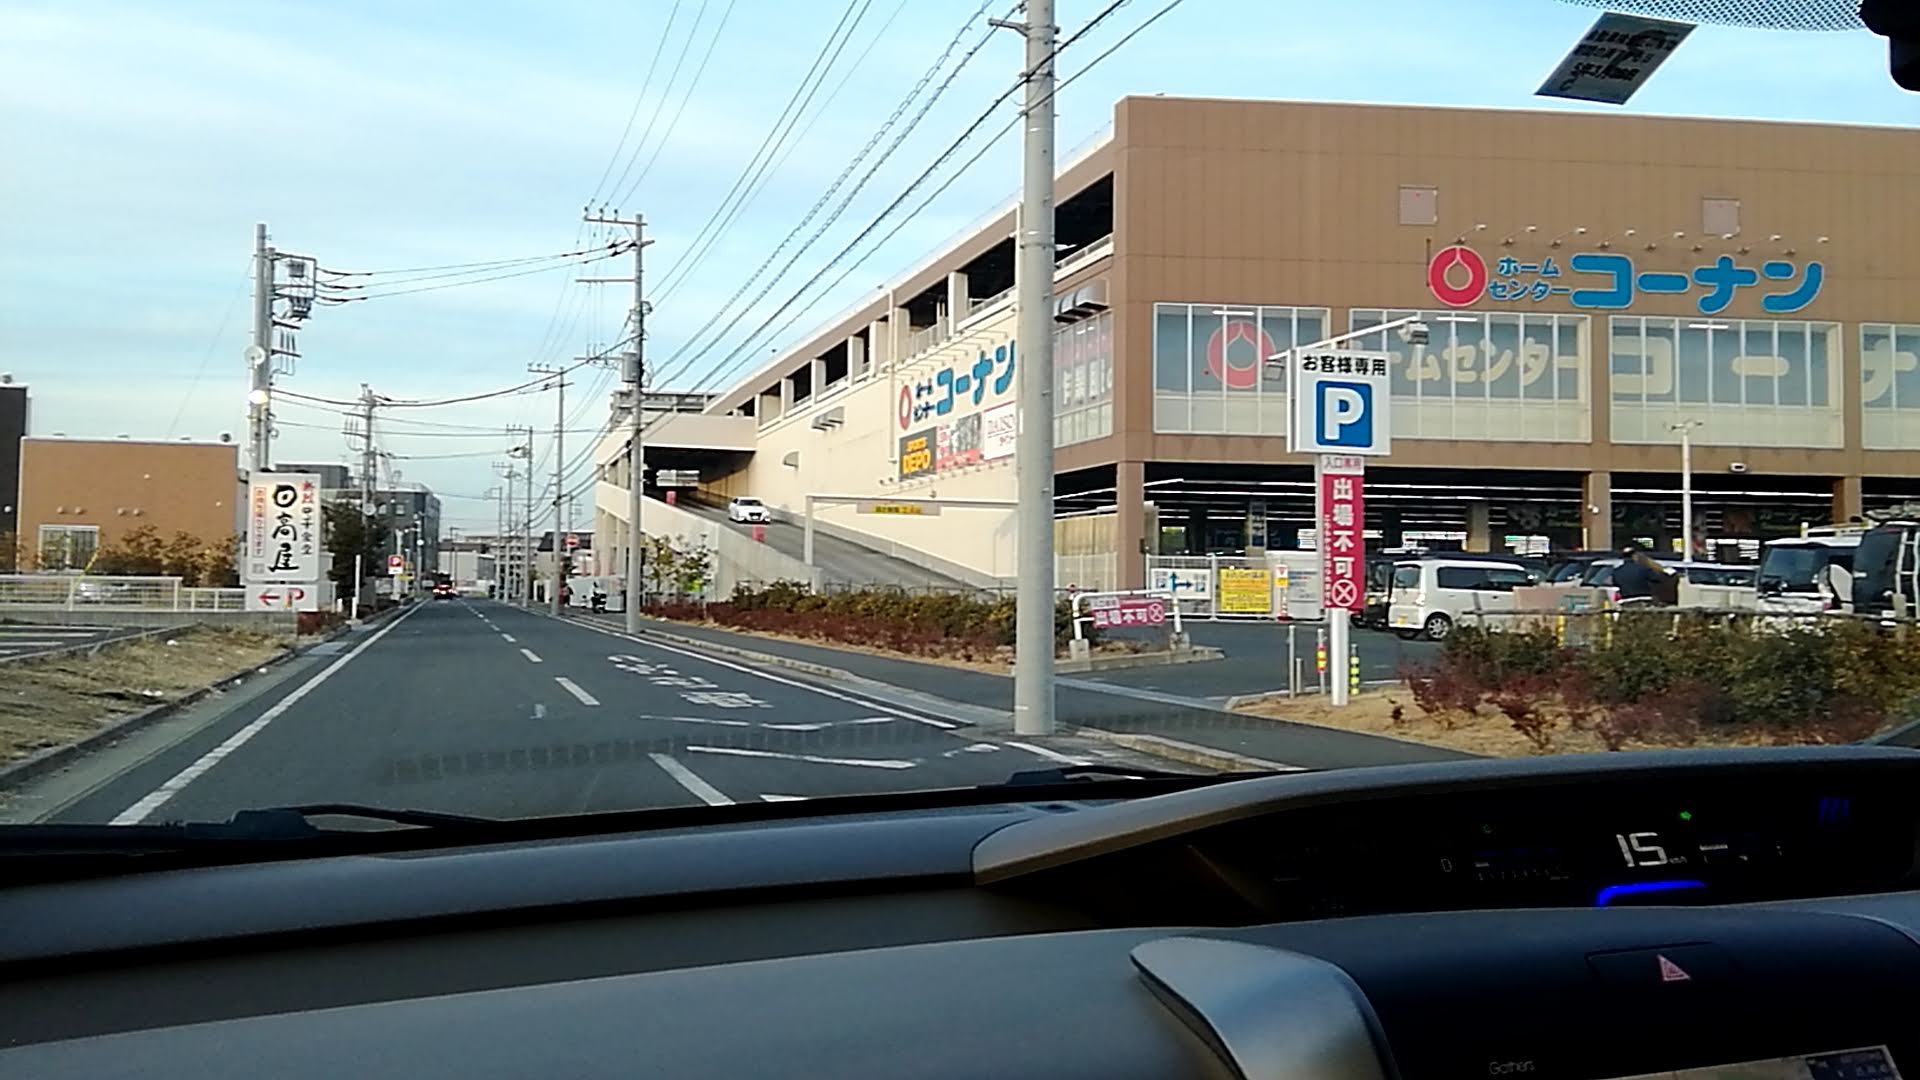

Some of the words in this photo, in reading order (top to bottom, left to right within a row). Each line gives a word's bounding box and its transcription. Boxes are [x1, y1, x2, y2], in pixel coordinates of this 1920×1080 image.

[1497, 257, 1561, 277] ホーム
[1570, 253, 1824, 313] コーナン
[1488, 281, 1571, 302] センター
[936, 339, 1015, 417] コーナン
[1302, 355, 1387, 377] お客様専用
[1323, 386, 1365, 441] P
[270, 484, 299, 572] 日高屋
[1332, 478, 1355, 578] 出場不可
[285, 587, 304, 608] P
[1095, 609, 1148, 625] 出場不可
[1616, 832, 1668, 866] 15
